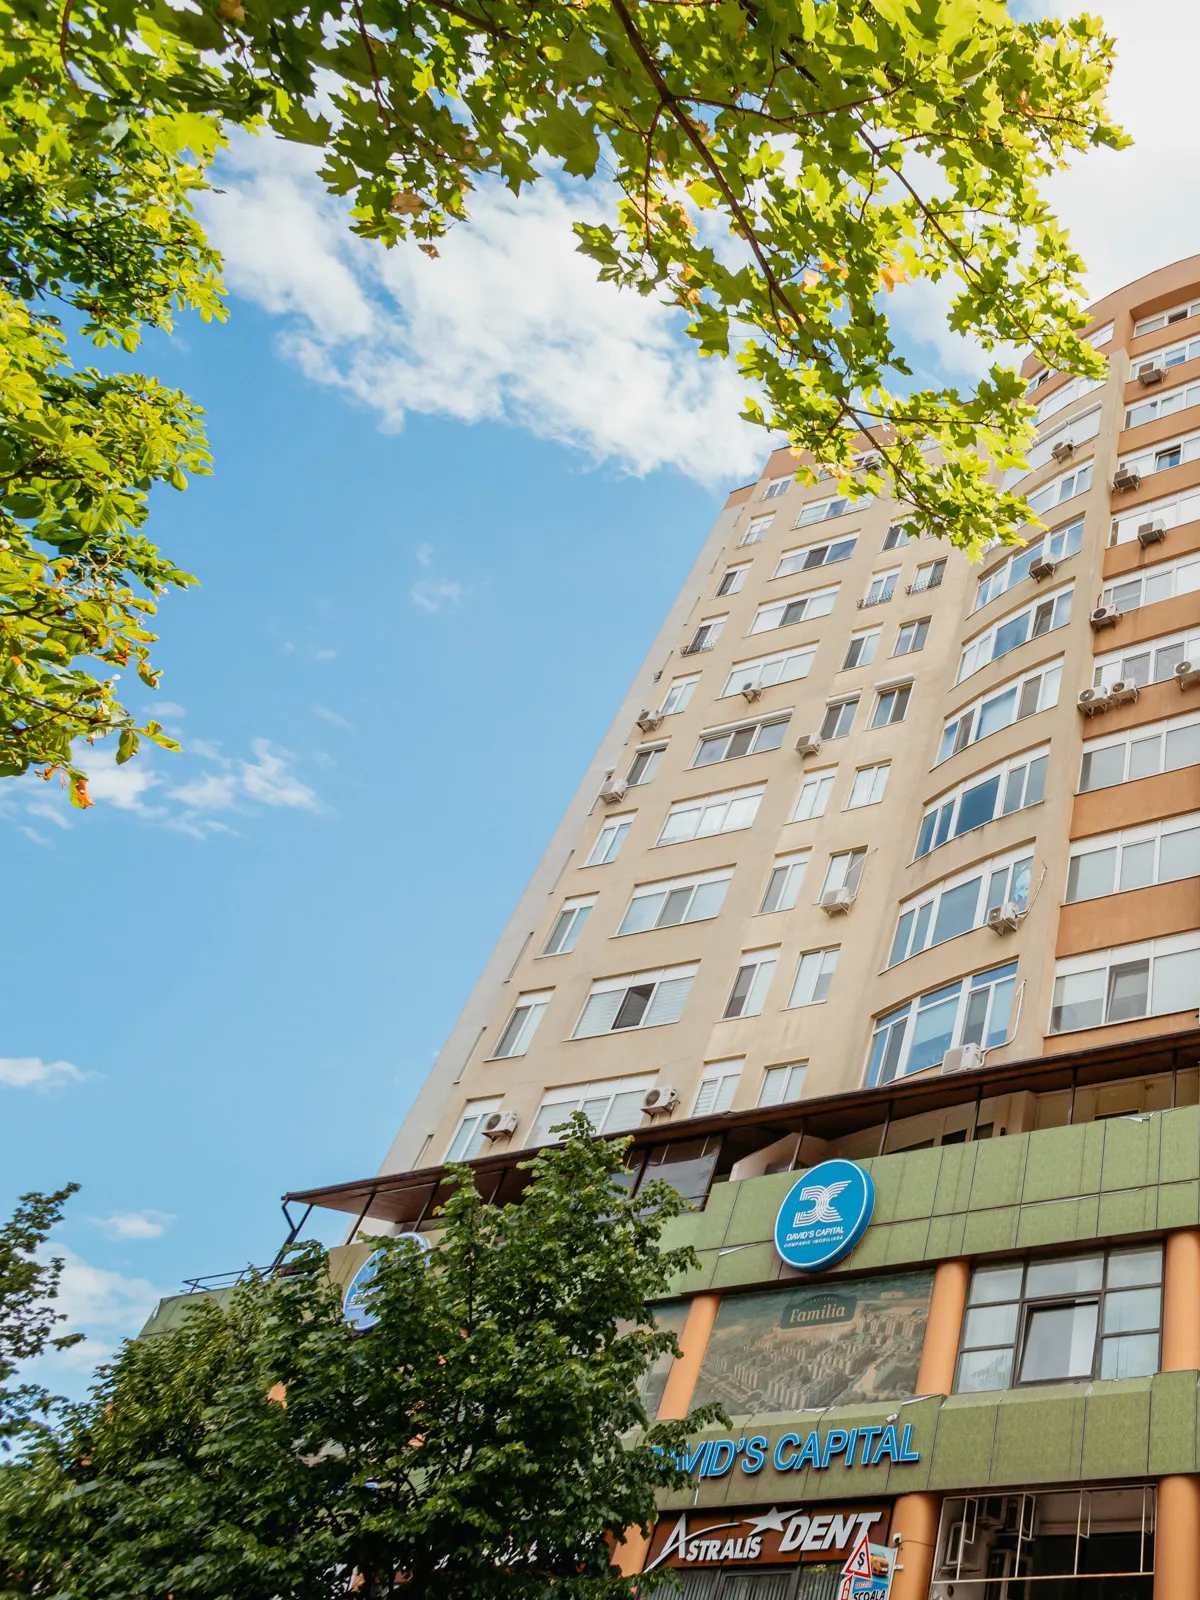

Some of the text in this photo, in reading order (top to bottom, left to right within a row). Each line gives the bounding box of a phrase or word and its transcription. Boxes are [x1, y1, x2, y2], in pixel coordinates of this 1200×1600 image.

[786, 1226, 844, 1241] DAVID'S CAPITAL
[789, 1304, 846, 1322] Familia
[774, 1423, 921, 1471] CAPITAL
[656, 1511, 883, 1563] ASTRALIS DENT
